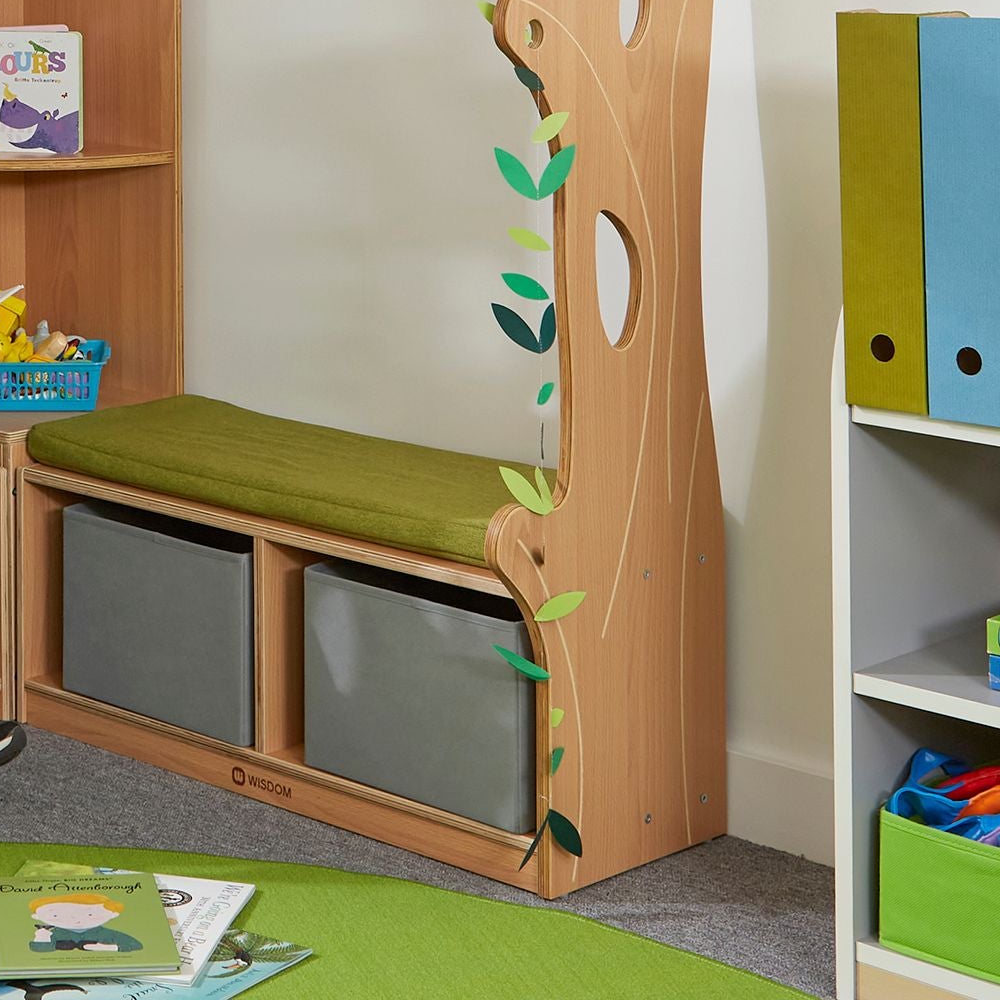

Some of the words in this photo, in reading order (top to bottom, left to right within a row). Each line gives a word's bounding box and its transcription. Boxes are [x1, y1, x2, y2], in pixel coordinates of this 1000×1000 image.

[248, 775, 292, 798] WISDOM
[48, 882, 142, 894] Attenborough
[180, 936, 206, 955] Bear
